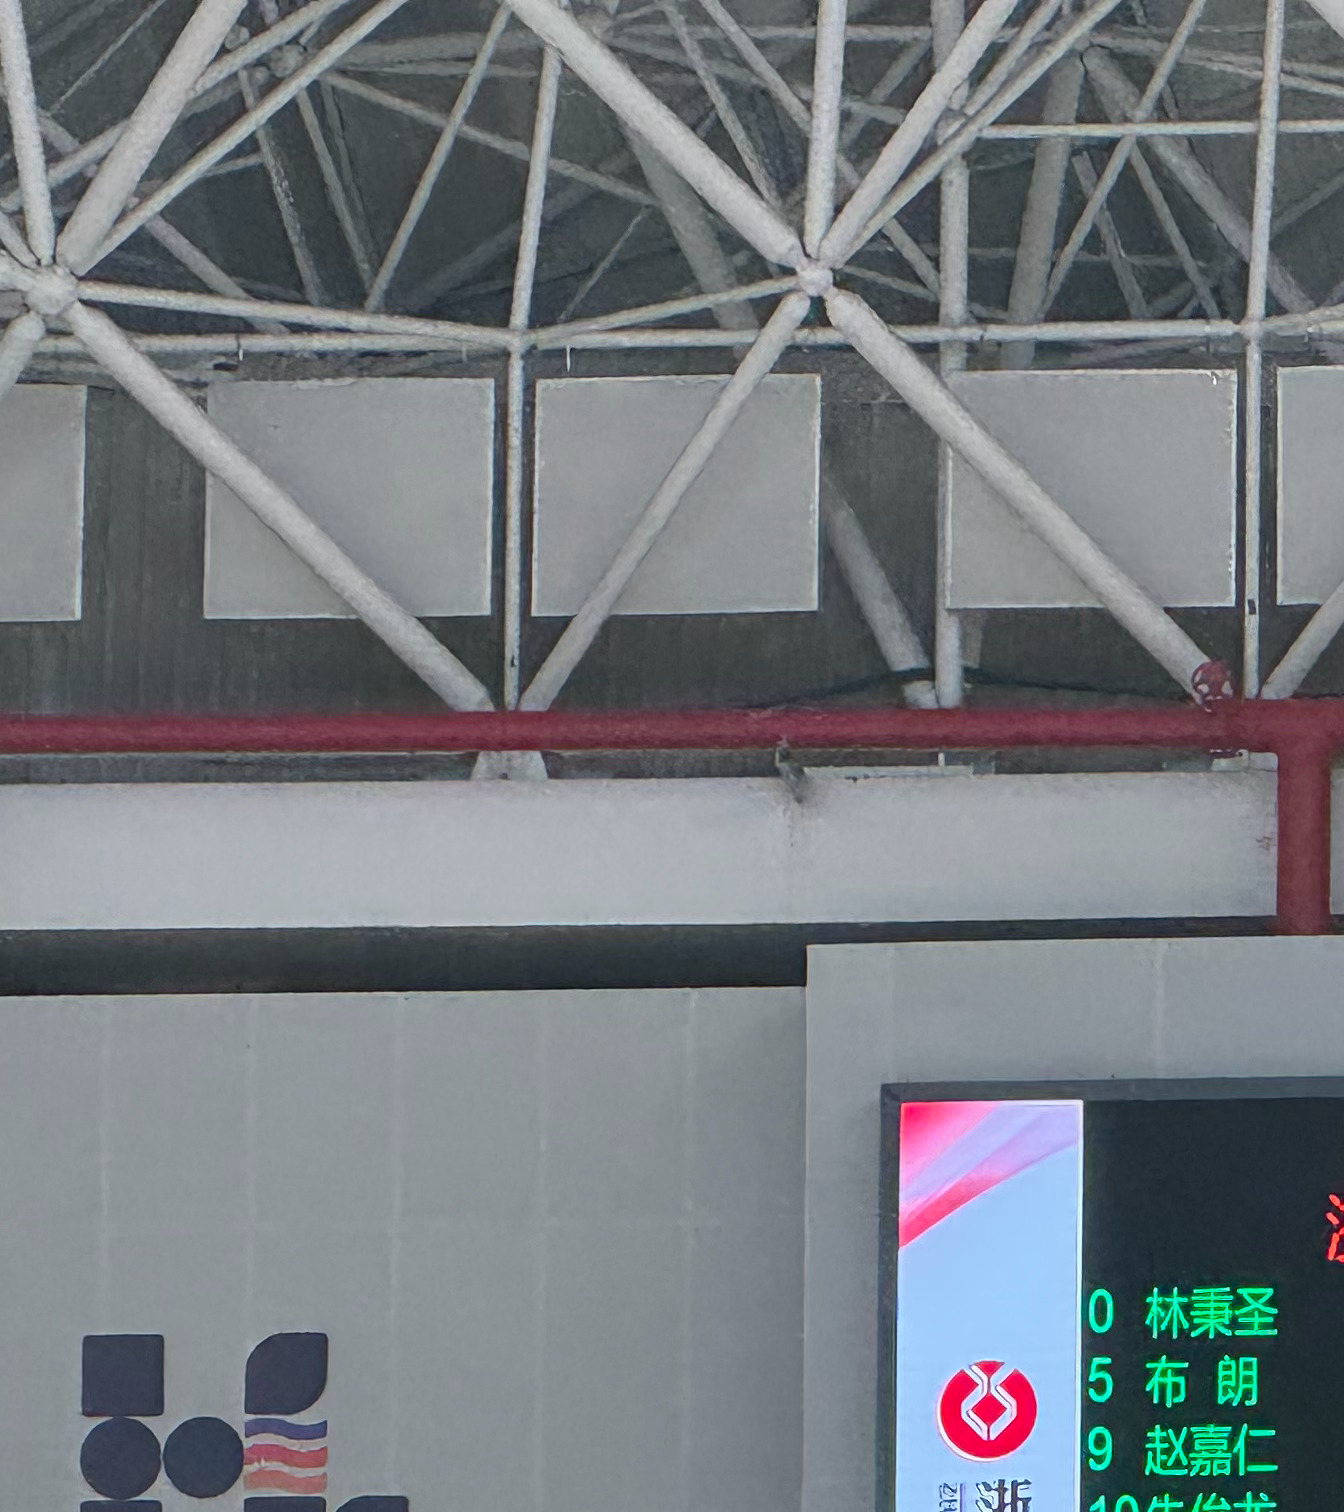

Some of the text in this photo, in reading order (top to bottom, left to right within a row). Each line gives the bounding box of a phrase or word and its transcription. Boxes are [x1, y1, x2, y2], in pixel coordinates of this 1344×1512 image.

[1088, 1289, 1114, 1335] 0
[1145, 1287, 1278, 1339] 林秉圣
[1088, 1357, 1114, 1403] 5
[1088, 1426, 1114, 1473] 9
[1145, 1424, 1278, 1476] 赵嘉仁
